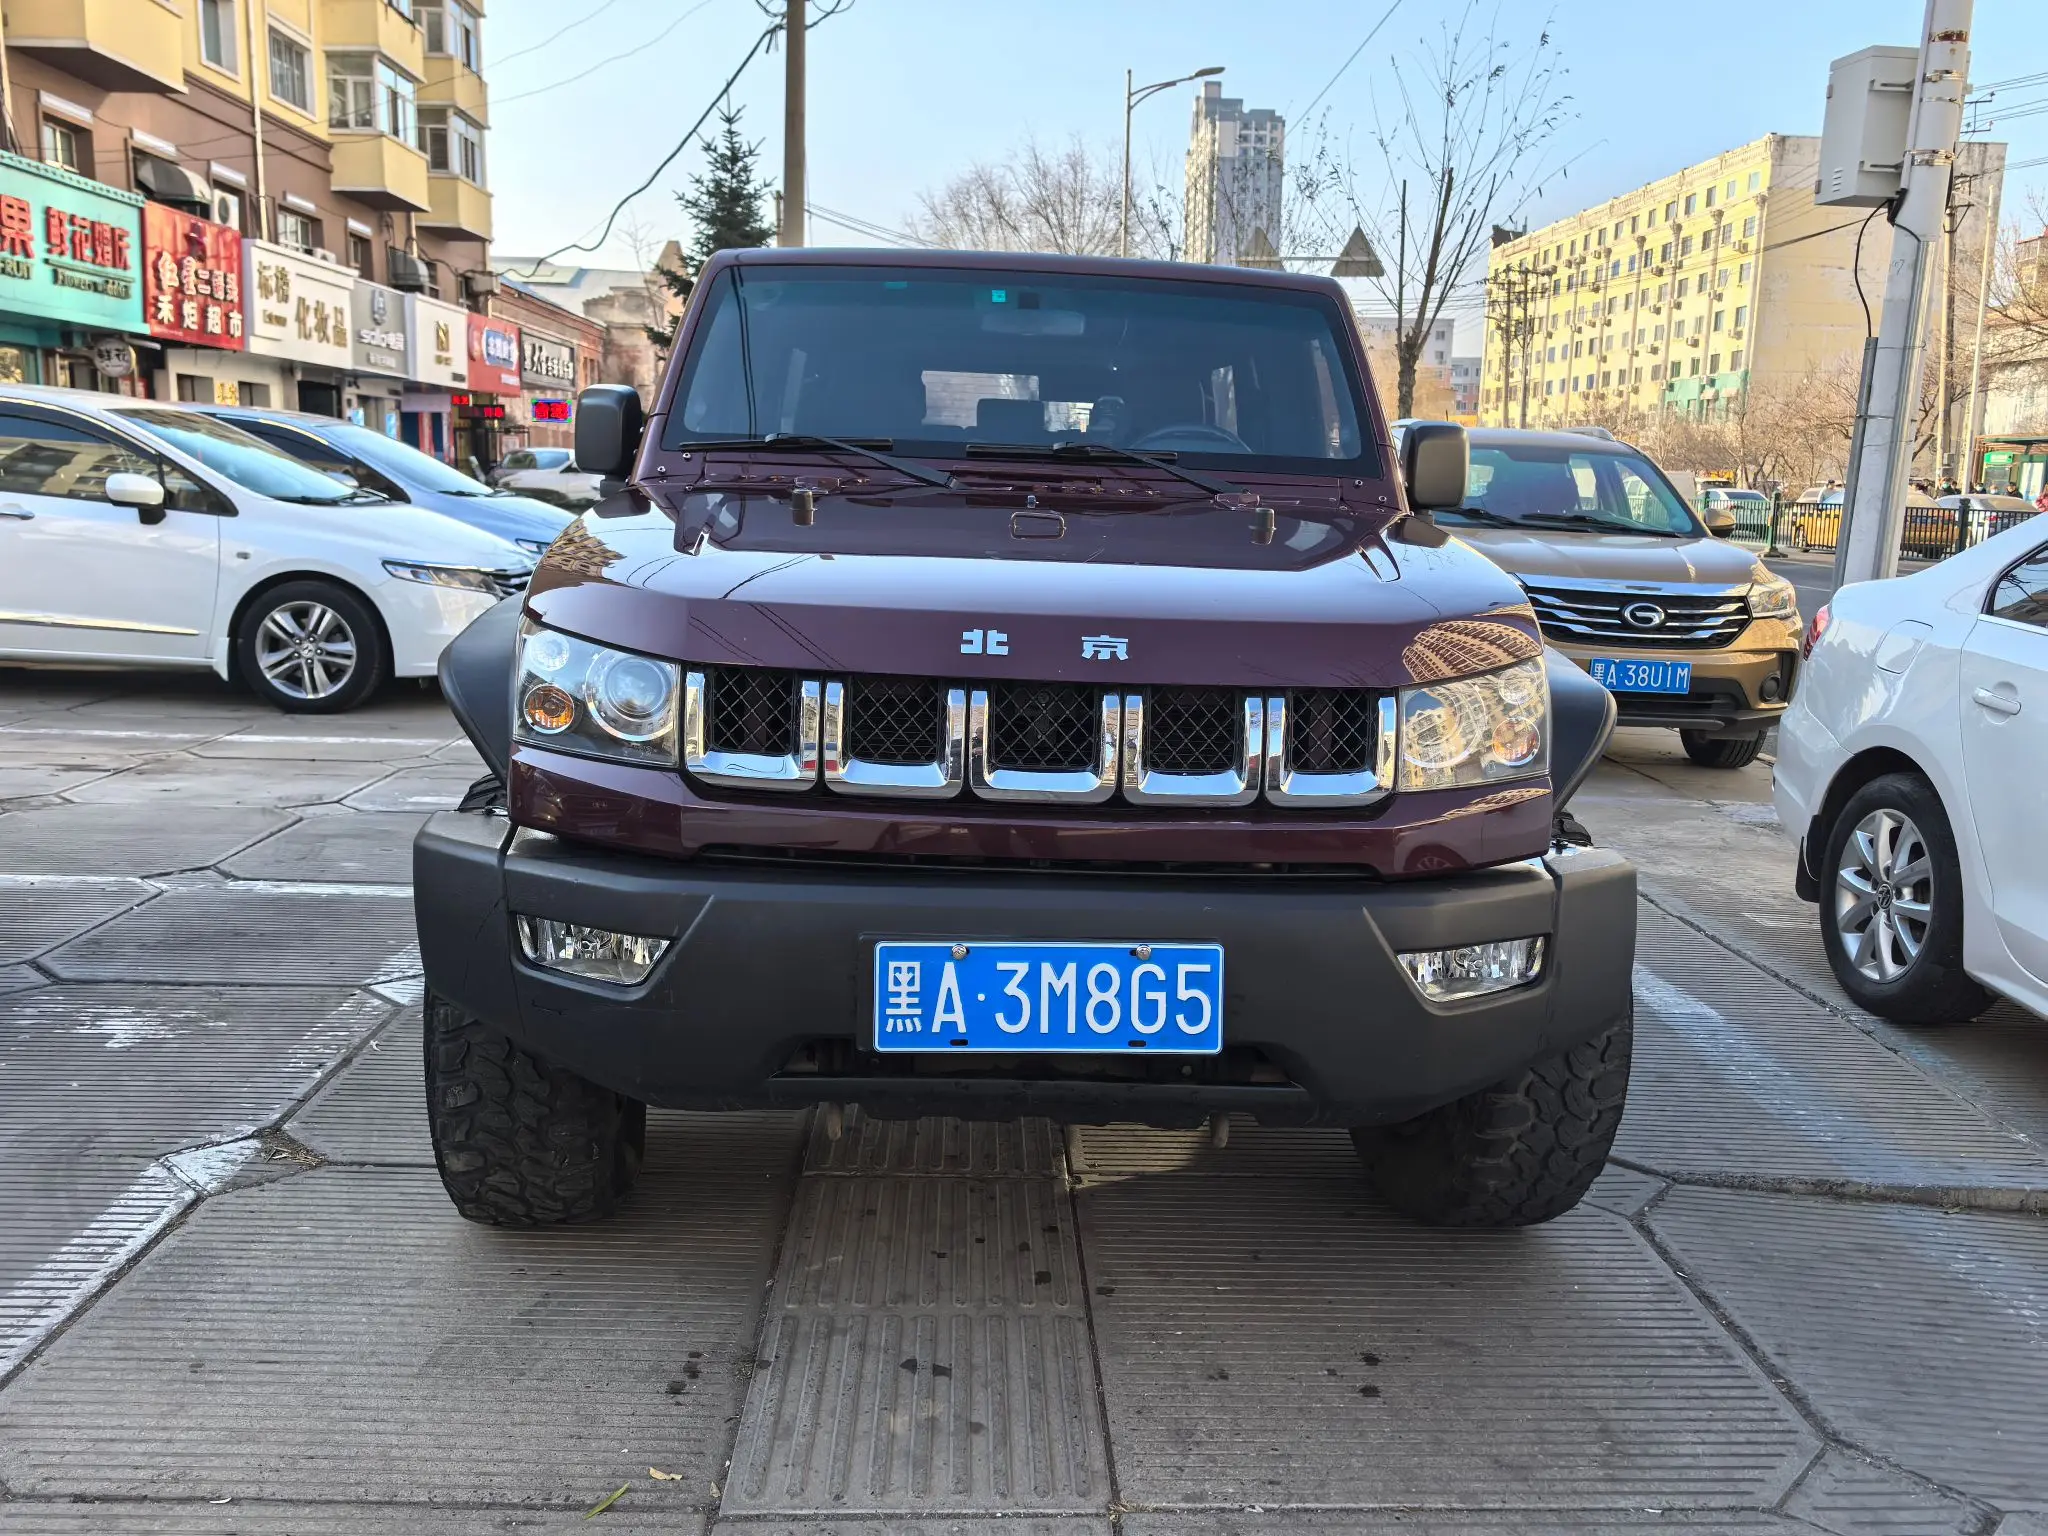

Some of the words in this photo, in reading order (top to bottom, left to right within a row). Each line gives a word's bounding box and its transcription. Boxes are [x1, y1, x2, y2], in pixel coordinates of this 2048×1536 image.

[0, 193, 35, 258] 果
[294, 296, 348, 349] 化妆品
[960, 628, 1129, 661] 北京
[885, 961, 1212, 1035] 黑A·3M8G5
